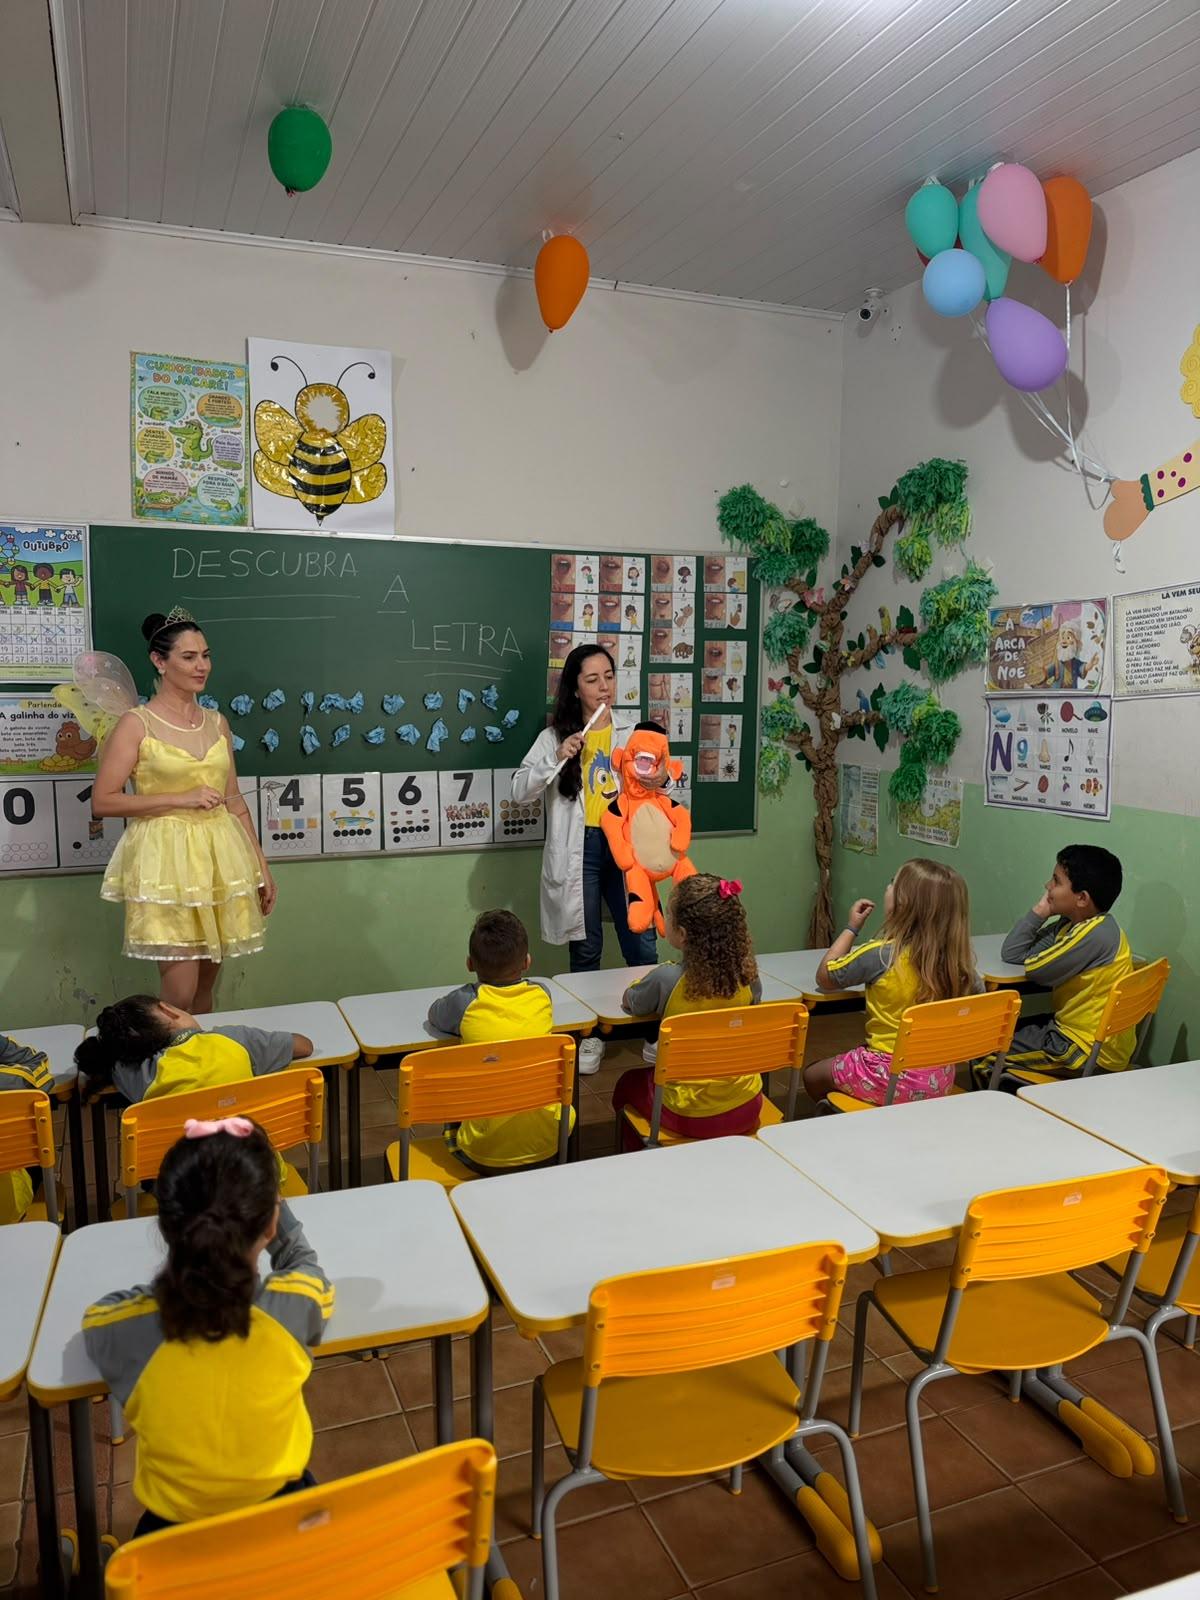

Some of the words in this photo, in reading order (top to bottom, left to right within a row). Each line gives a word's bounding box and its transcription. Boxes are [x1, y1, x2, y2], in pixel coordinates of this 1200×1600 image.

[146, 360, 235, 380] CURIOSIDADES
[153, 373, 171, 384] DO
[174, 375, 228, 391] JACARÉ!
[23, 541, 69, 552] OUTUBRO
[172, 548, 359, 579] DESCUBRA
[382, 574, 410, 603] A
[1006, 618, 1014, 631] A
[411, 619, 524, 661] LETRA
[995, 637, 1025, 651] ARCA
[1004, 651, 1019, 662] DE
[10, 712, 44, 721] galinha
[991, 732, 1013, 772] N
[278, 779, 304, 812] 4
[341, 777, 365, 808] 5
[398, 776, 422, 806] 6
[453, 772, 474, 801] 7
[3, 787, 35, 825] 0
